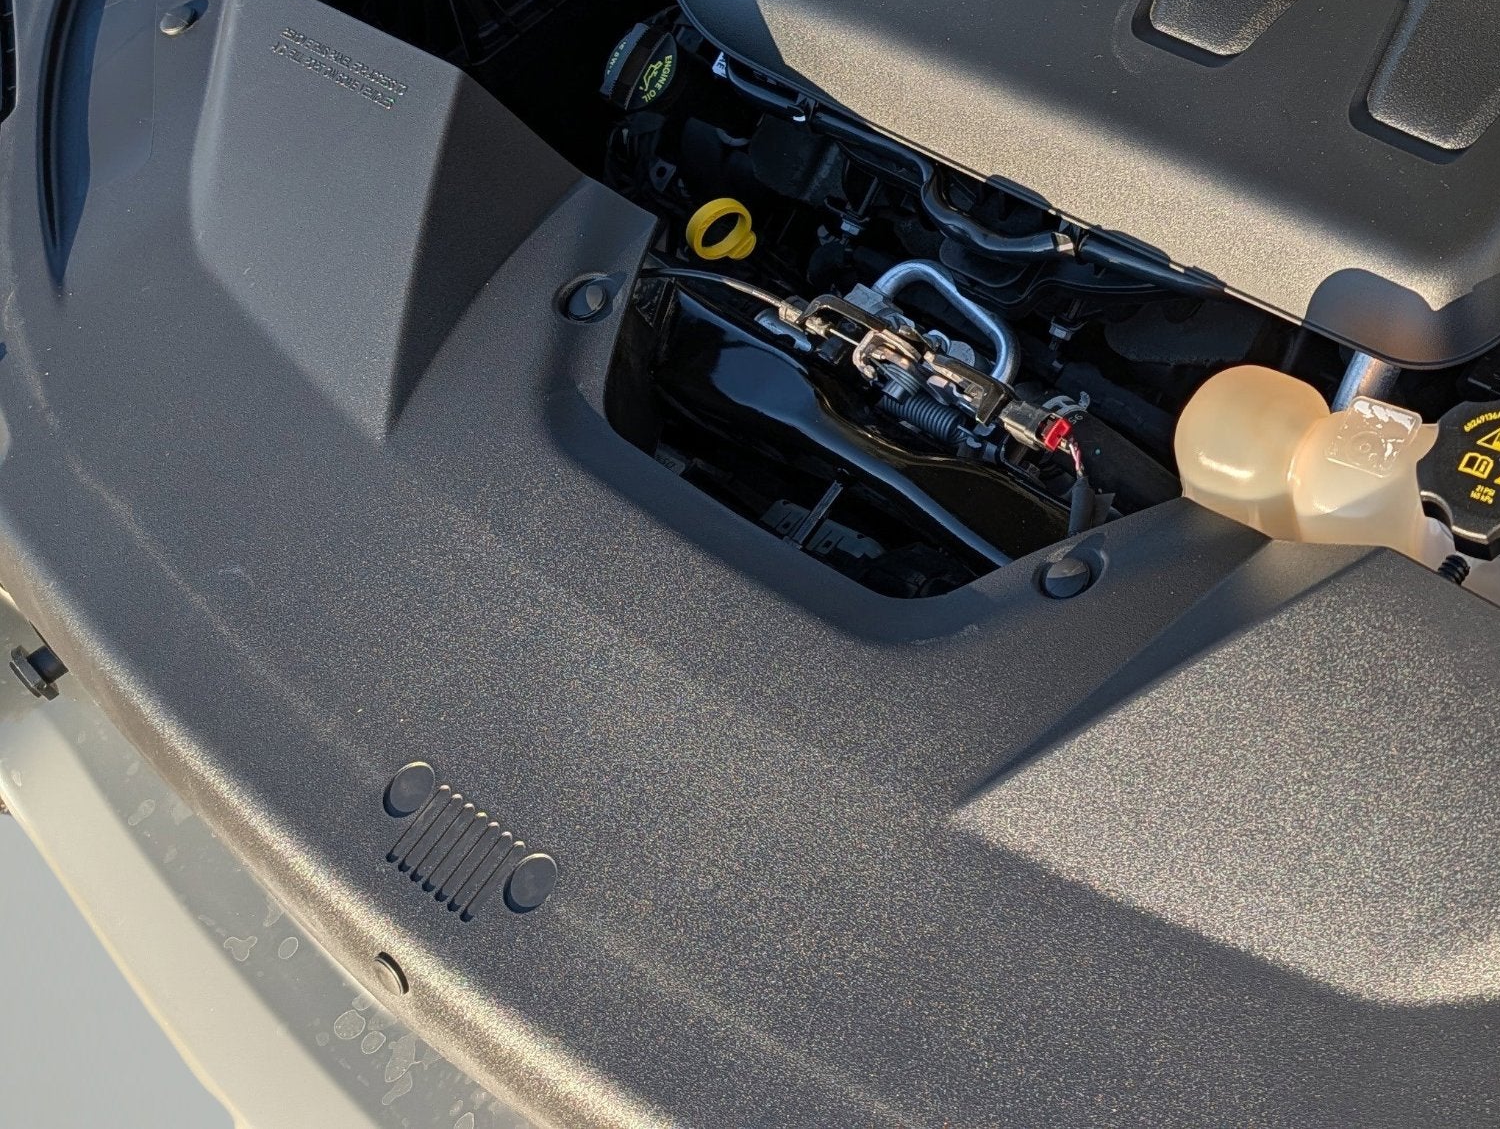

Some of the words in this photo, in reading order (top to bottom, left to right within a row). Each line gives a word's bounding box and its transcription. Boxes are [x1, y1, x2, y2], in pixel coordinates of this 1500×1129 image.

[655, 55, 672, 90] ENGINE
[642, 90, 656, 102] OIL
[1484, 485, 1496, 495] PSI
